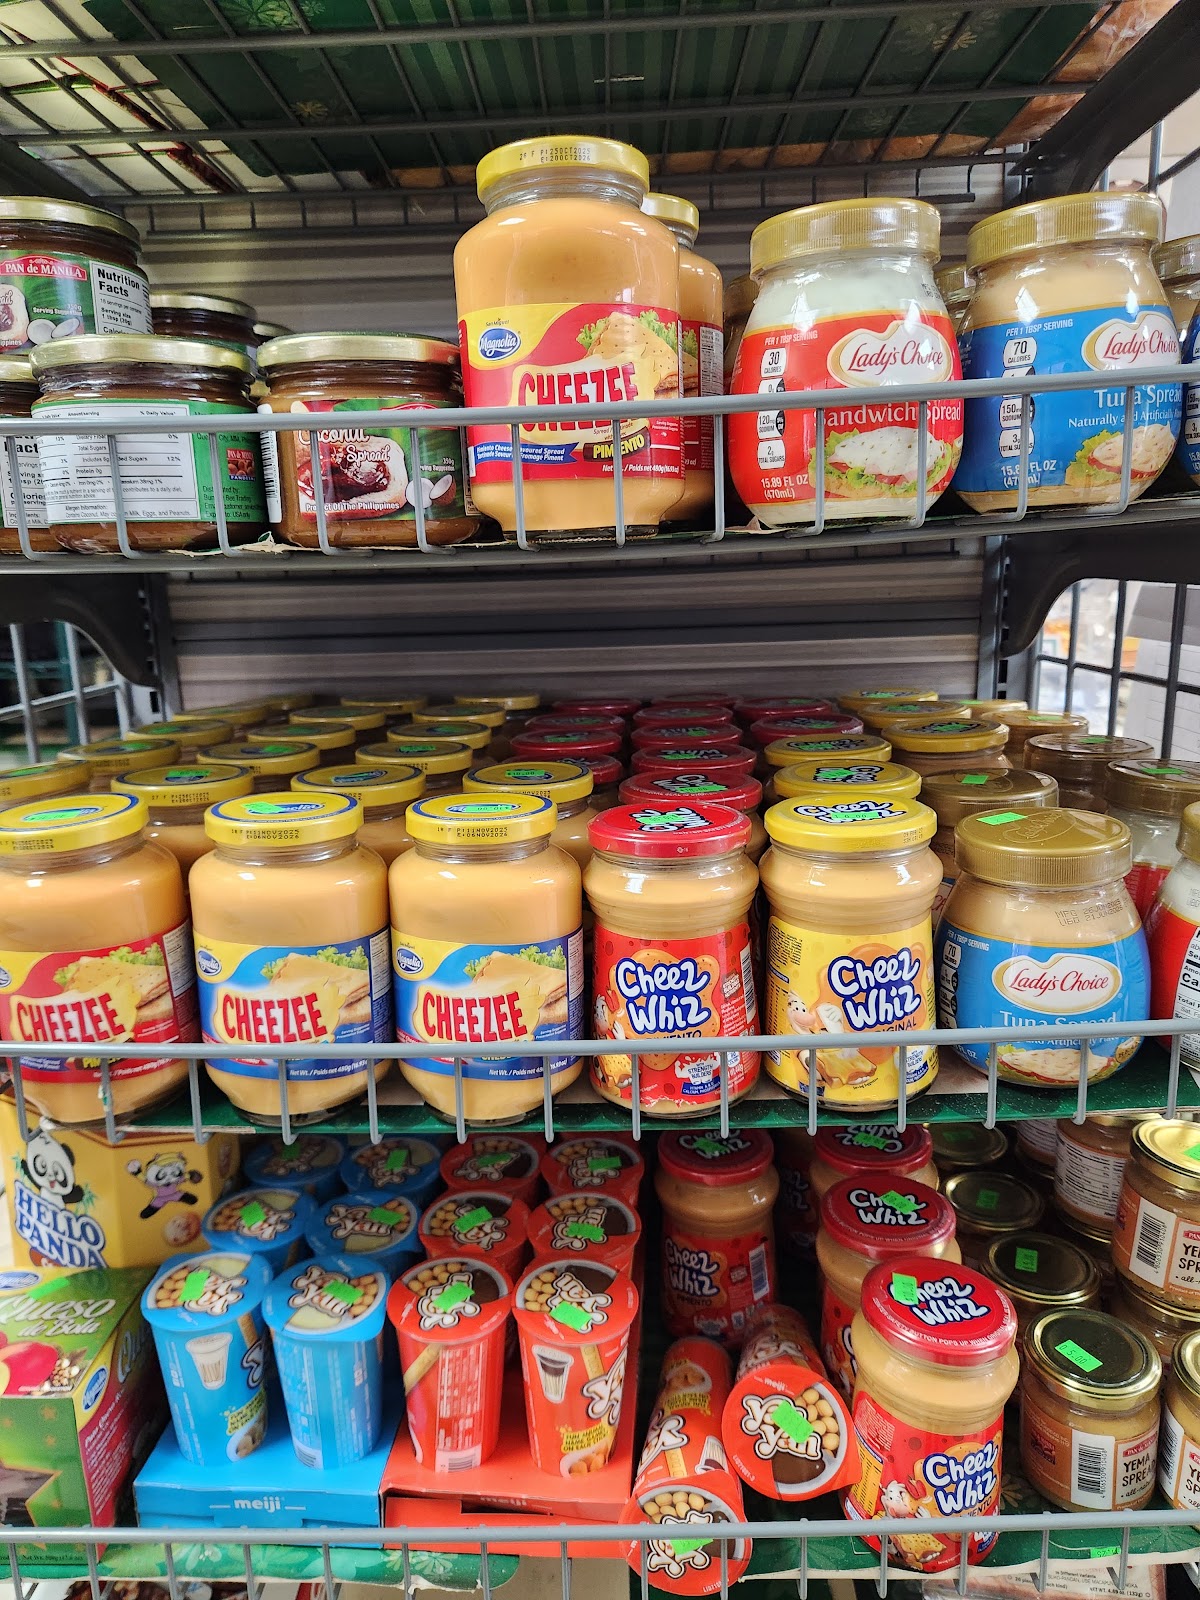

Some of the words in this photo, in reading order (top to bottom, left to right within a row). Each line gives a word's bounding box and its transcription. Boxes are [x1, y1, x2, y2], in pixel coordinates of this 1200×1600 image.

[5, 264, 24, 273] PAN
[26, 264, 38, 273] de
[40, 265, 82, 279] MANILA
[97, 267, 140, 290] Nutrition
[98, 280, 129, 297] Facts
[1006, 328, 1018, 337] PER
[1025, 324, 1042, 335] TBSP
[1043, 318, 1073, 333] SERVING
[479, 332, 517, 357] Magnolia
[764, 336, 775, 346] PER
[780, 335, 792, 344] TBSP
[792, 330, 818, 342] SERVING
[1013, 340, 1028, 355] 70
[1103, 331, 1146, 364] Lady's
[1149, 329, 1178, 355] Choice
[768, 351, 780, 366] 30
[848, 342, 900, 376] Lady's
[900, 339, 943, 366] Choice
[1008, 354, 1031, 364] CALORIES
[764, 366, 781, 375] CALORIES
[518, 361, 639, 432] CHEEZEE
[1068, 413, 1119, 429] Naturally
[346, 444, 391, 465] Spread
[543, 448, 566, 456] Spread
[592, 433, 645, 459] PIMENTO
[628, 464, 644, 473] Poids
[758, 456, 770, 464] TOTAL
[770, 454, 785, 463] SUGARS
[1030, 461, 1042, 473] FL
[1043, 460, 1057, 471] OZ
[761, 477, 783, 489] 15.89
[783, 476, 795, 488] FL
[796, 475, 809, 486] OZ
[764, 487, 796, 500] (470mL)
[332, 502, 342, 511] Of
[343, 502, 357, 511] The
[358, 502, 400, 512] Philippines
[795, 801, 894, 818] Cheez
[948, 943, 956, 957] 70
[968, 937, 990, 952] SERVING
[617, 958, 710, 998] Cheez
[831, 949, 921, 996] Cheez
[1008, 968, 1060, 998] Lady's
[1060, 970, 1110, 993] Choice
[422, 990, 527, 1043] CHEEZEE
[627, 994, 711, 1032] Whiz
[845, 984, 921, 1029] Whiz
[17, 991, 126, 1043] CHEEZEE
[222, 992, 327, 1044] CHEEZEE
[687, 1063, 714, 1074] STRENGTH
[18, 1188, 101, 1247] HELLO
[857, 1208, 927, 1226] Whiz
[18, 1213, 101, 1268] PANDA
[669, 1266, 718, 1296] Whiz
[912, 1297, 990, 1326] Whiz
[17, 1320, 48, 1337] de
[45, 1317, 102, 1337] Bola
[924, 1441, 999, 1488] Cheez
[1123, 1452, 1151, 1473] YEMA
[1122, 1459, 1156, 1487] SPREAD
[935, 1472, 998, 1515] Whiz
[234, 1497, 281, 1514] meiji
